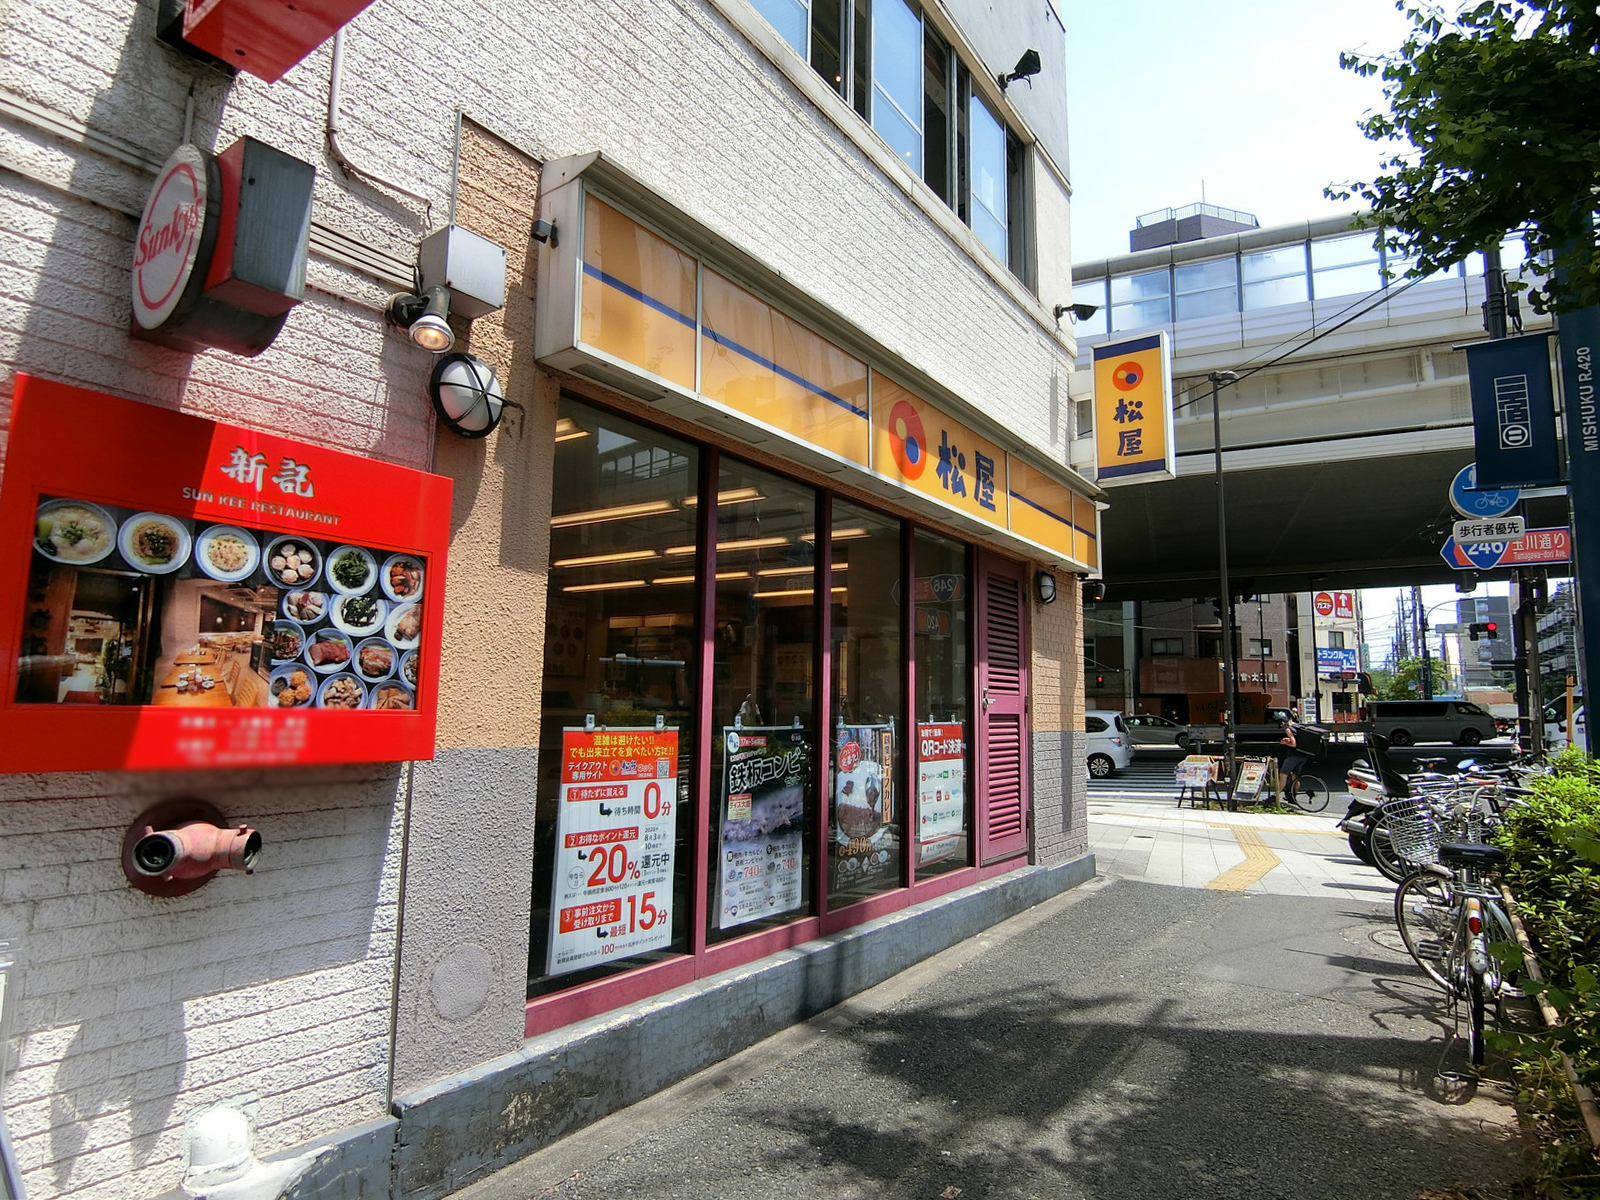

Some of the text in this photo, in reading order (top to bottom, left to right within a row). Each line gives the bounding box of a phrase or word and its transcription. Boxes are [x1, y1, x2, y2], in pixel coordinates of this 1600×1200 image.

[1576, 346, 1599, 452] MISHUKU R.420
[1113, 398, 1144, 457] 松屋
[220, 445, 316, 498] 新記
[935, 429, 997, 513] 松屋
[182, 486, 341, 526] SUN KEE RESTAURANT
[1459, 521, 1520, 538] 歩行者優先
[1468, 532, 1565, 556] 246 玉川通り
[1514, 549, 1567, 561] Tamagawa-dori Ave.
[1317, 649, 1355, 660] トランクルーム
[921, 738, 963, 757] QRコード決済
[568, 760, 608, 771] テイクアウト
[728, 747, 802, 794] 鉄板コンビ
[571, 770, 603, 780] 専用サイト
[580, 787, 625, 799] 待たずに買える
[614, 805, 641, 816] 待ち時間
[578, 829, 636, 845] お得なポイント還元
[641, 852, 670, 869] 還元中
[573, 901, 616, 919] 事前注文から
[573, 912, 614, 930] 受け取りまで
[609, 924, 627, 938] 最短
